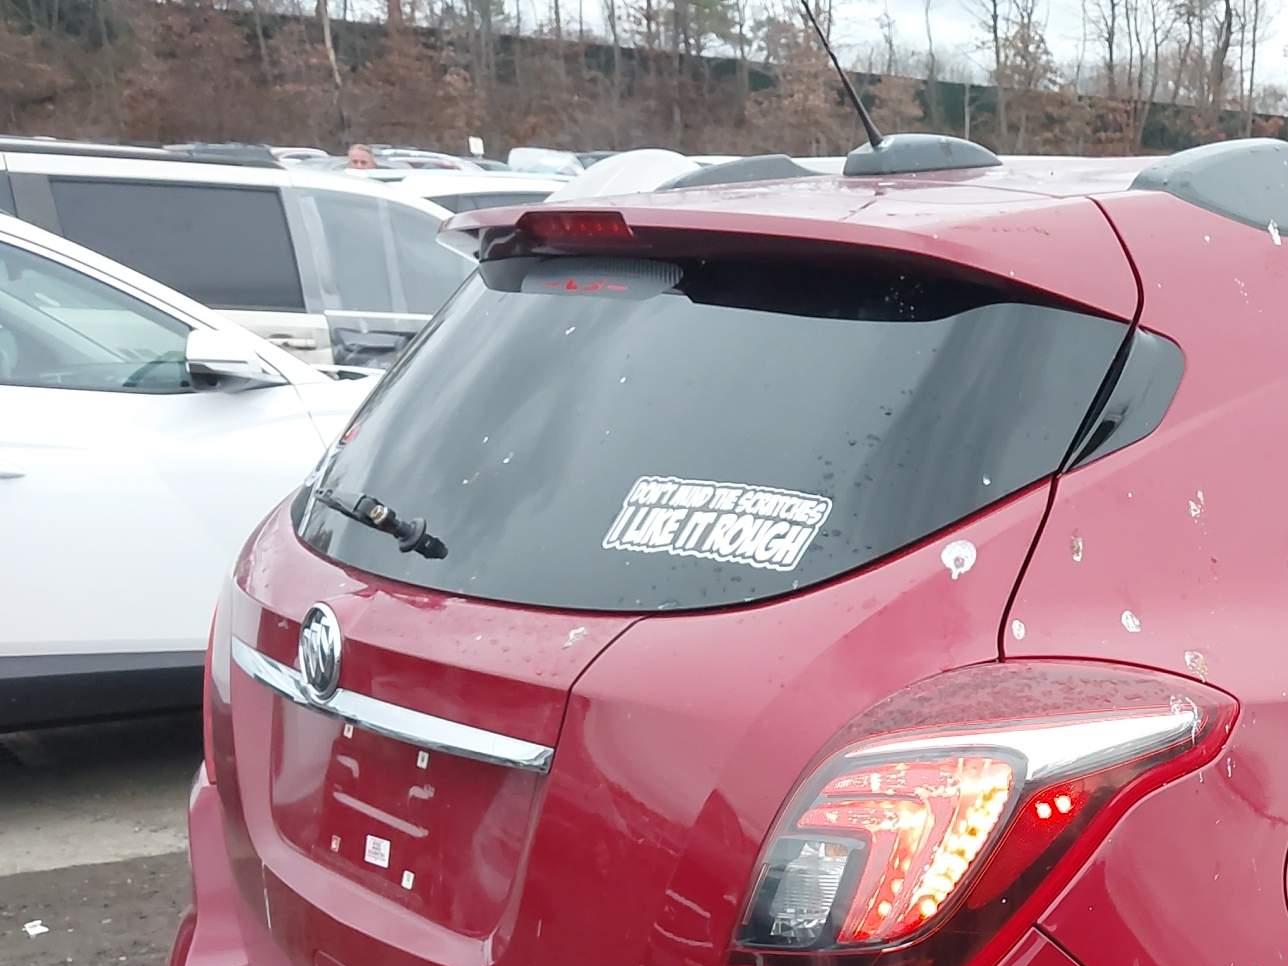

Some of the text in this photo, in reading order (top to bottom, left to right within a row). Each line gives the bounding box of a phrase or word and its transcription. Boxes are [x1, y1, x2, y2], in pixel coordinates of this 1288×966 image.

[630, 481, 828, 525] DON'T MIND THE SCRATCHES
[609, 506, 812, 564] I LIKE IT ROUGH
